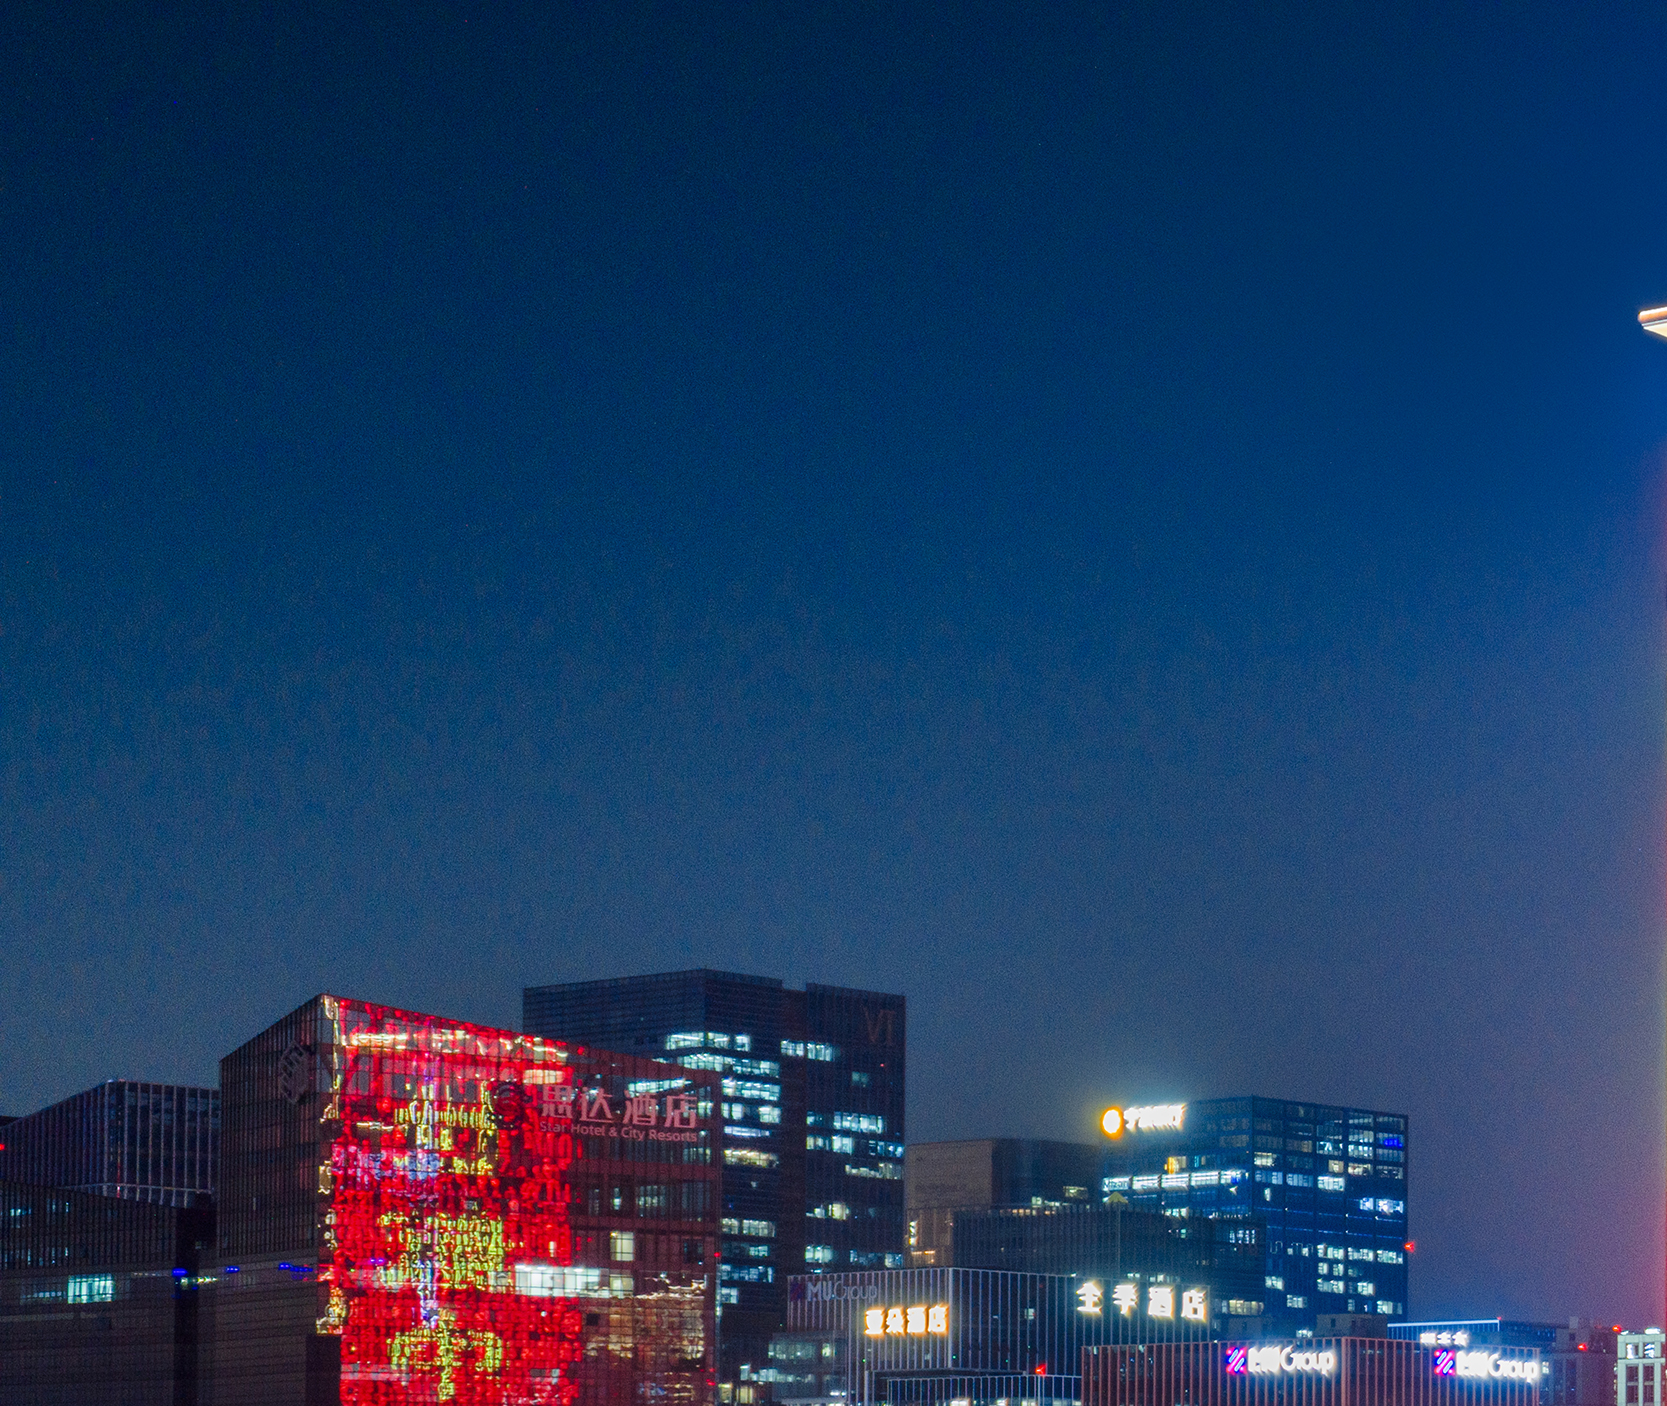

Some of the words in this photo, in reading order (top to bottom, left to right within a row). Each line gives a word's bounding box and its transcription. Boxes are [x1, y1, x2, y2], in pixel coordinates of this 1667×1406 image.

[541, 1084, 698, 1129] 思达酒店
[539, 1121, 567, 1133] Star
[571, 1123, 605, 1136] Hotel
[610, 1127, 619, 1137] &
[621, 1127, 645, 1141] City
[649, 1129, 698, 1142] Resorts
[1076, 1281, 1207, 1321] 全季酒店
